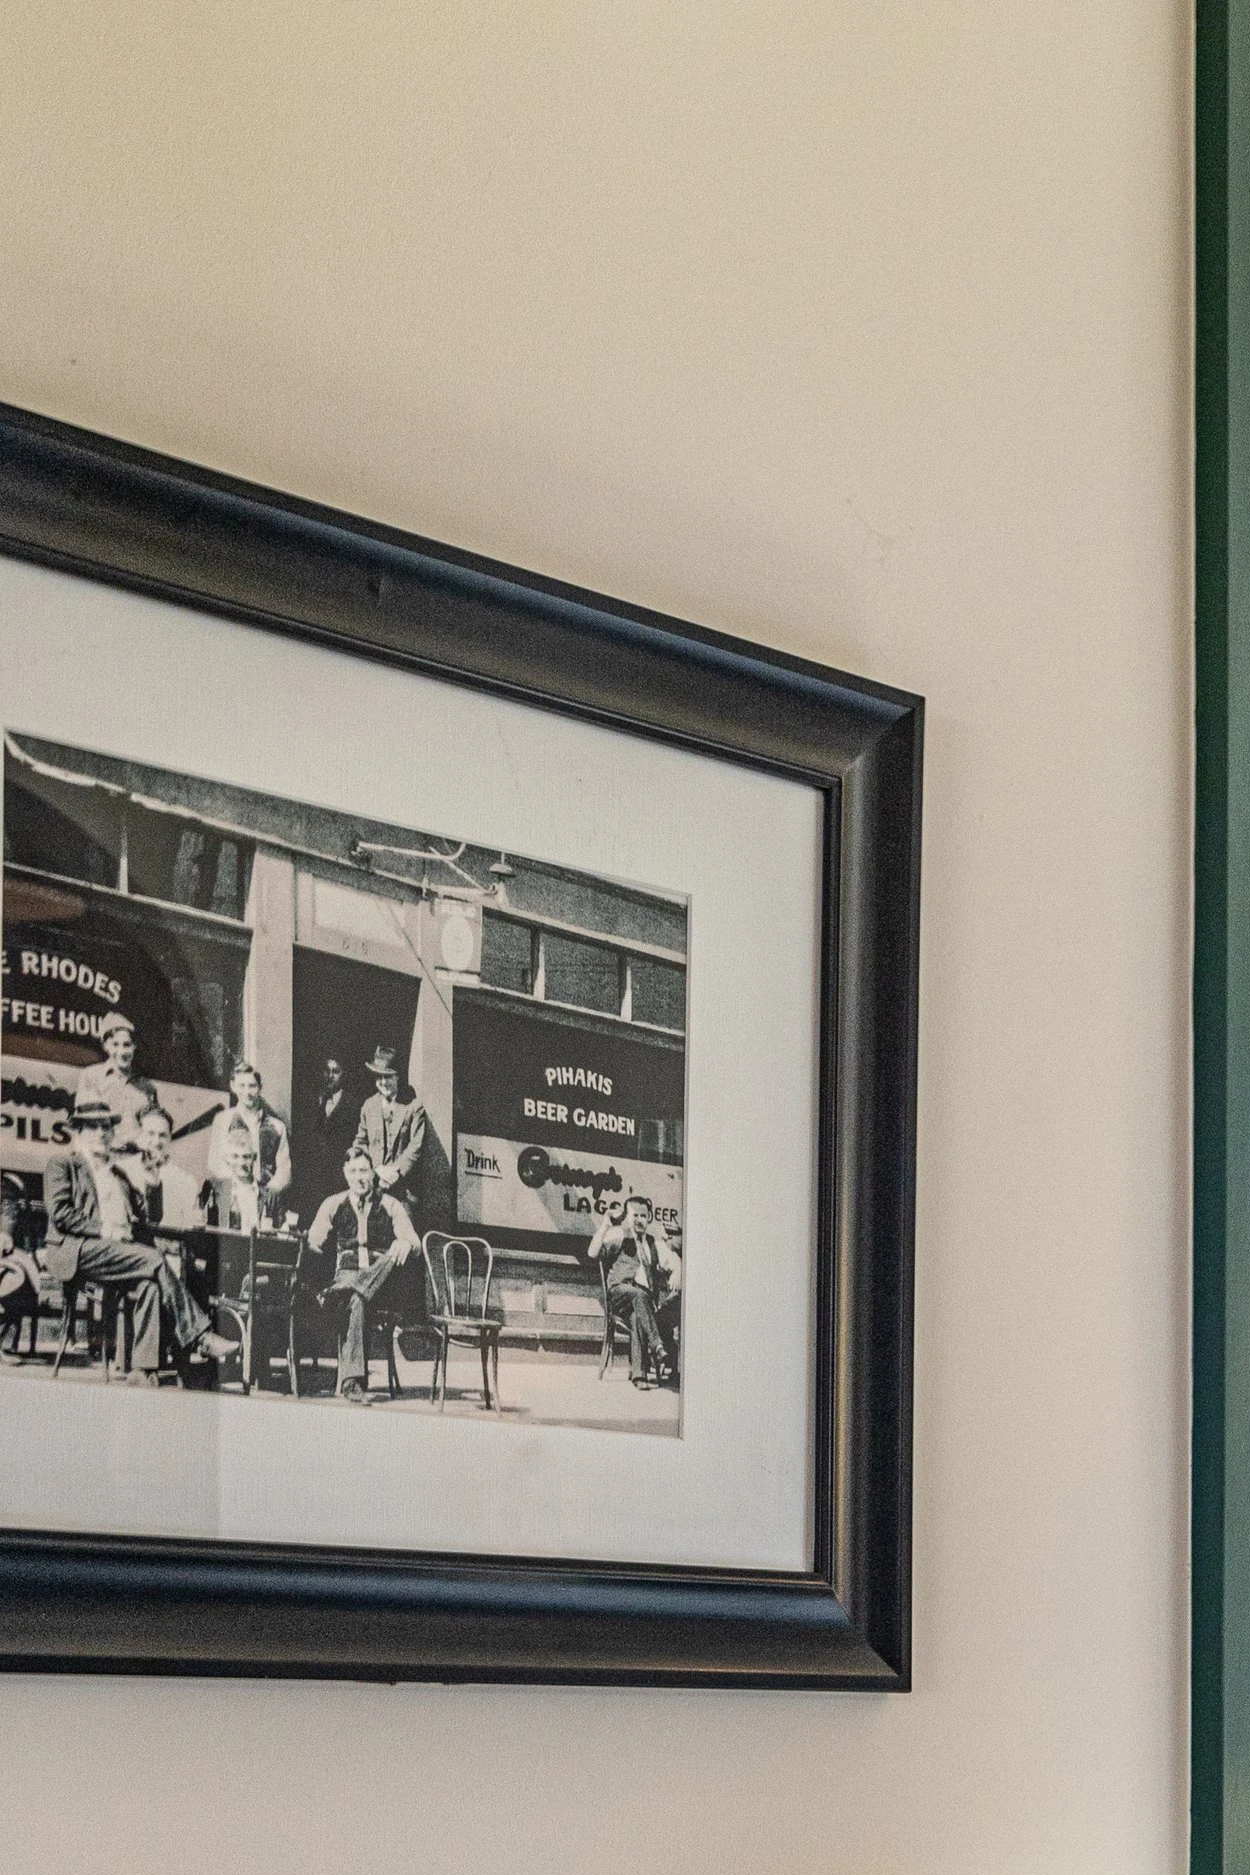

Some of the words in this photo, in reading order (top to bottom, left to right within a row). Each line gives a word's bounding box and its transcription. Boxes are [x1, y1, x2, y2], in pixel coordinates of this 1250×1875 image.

[21, 951, 122, 1004] RHODES
[59, 1008, 103, 1039] HOU
[545, 1066, 613, 1096] PIHAKIS
[524, 1098, 568, 1123] BEER
[573, 1108, 636, 1136] GARDEN
[464, 1148, 501, 1174] Drink
